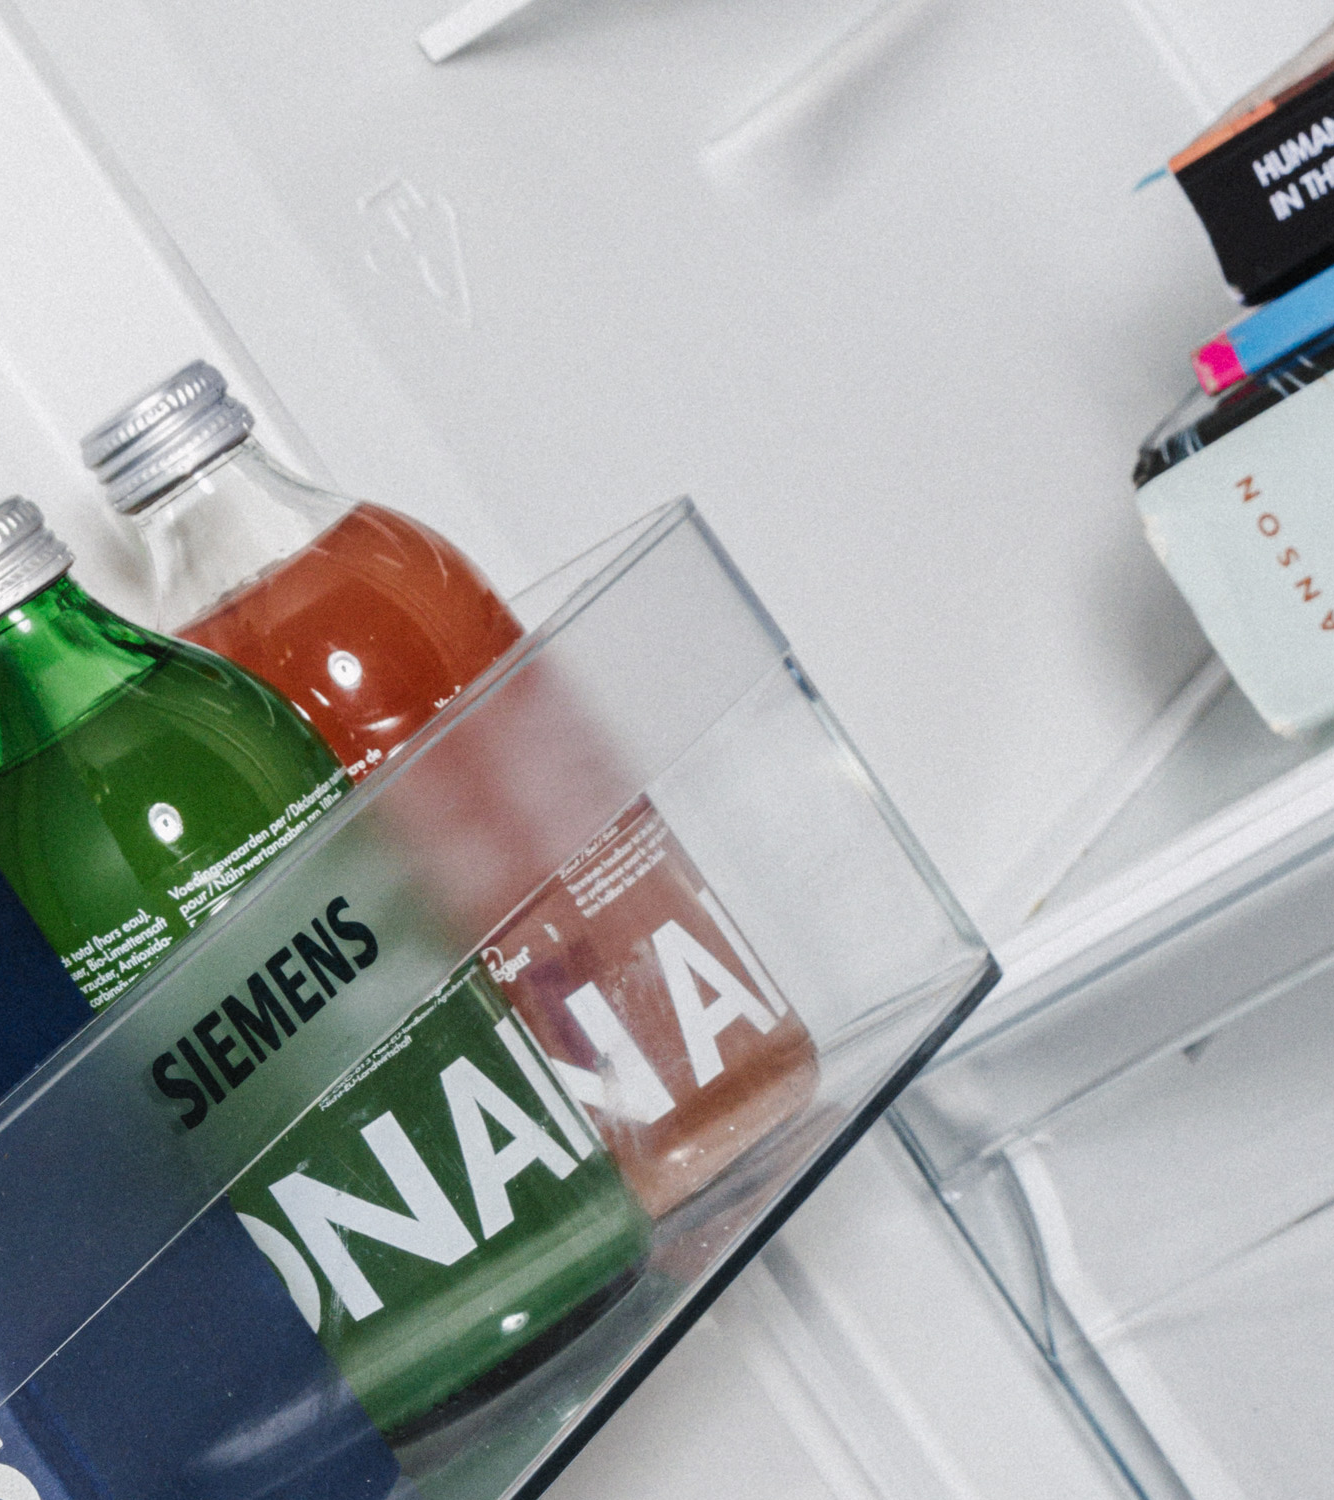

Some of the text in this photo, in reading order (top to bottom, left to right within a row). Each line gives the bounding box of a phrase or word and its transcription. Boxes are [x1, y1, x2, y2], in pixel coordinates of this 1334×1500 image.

[1269, 183, 1305, 222] IN
[167, 828, 271, 900] Voedingswaarden
[179, 895, 207, 918] pour
[71, 939, 96, 963] total
[87, 916, 168, 973] Bio-Limettensaft
[152, 895, 380, 1131] SIEMENS
